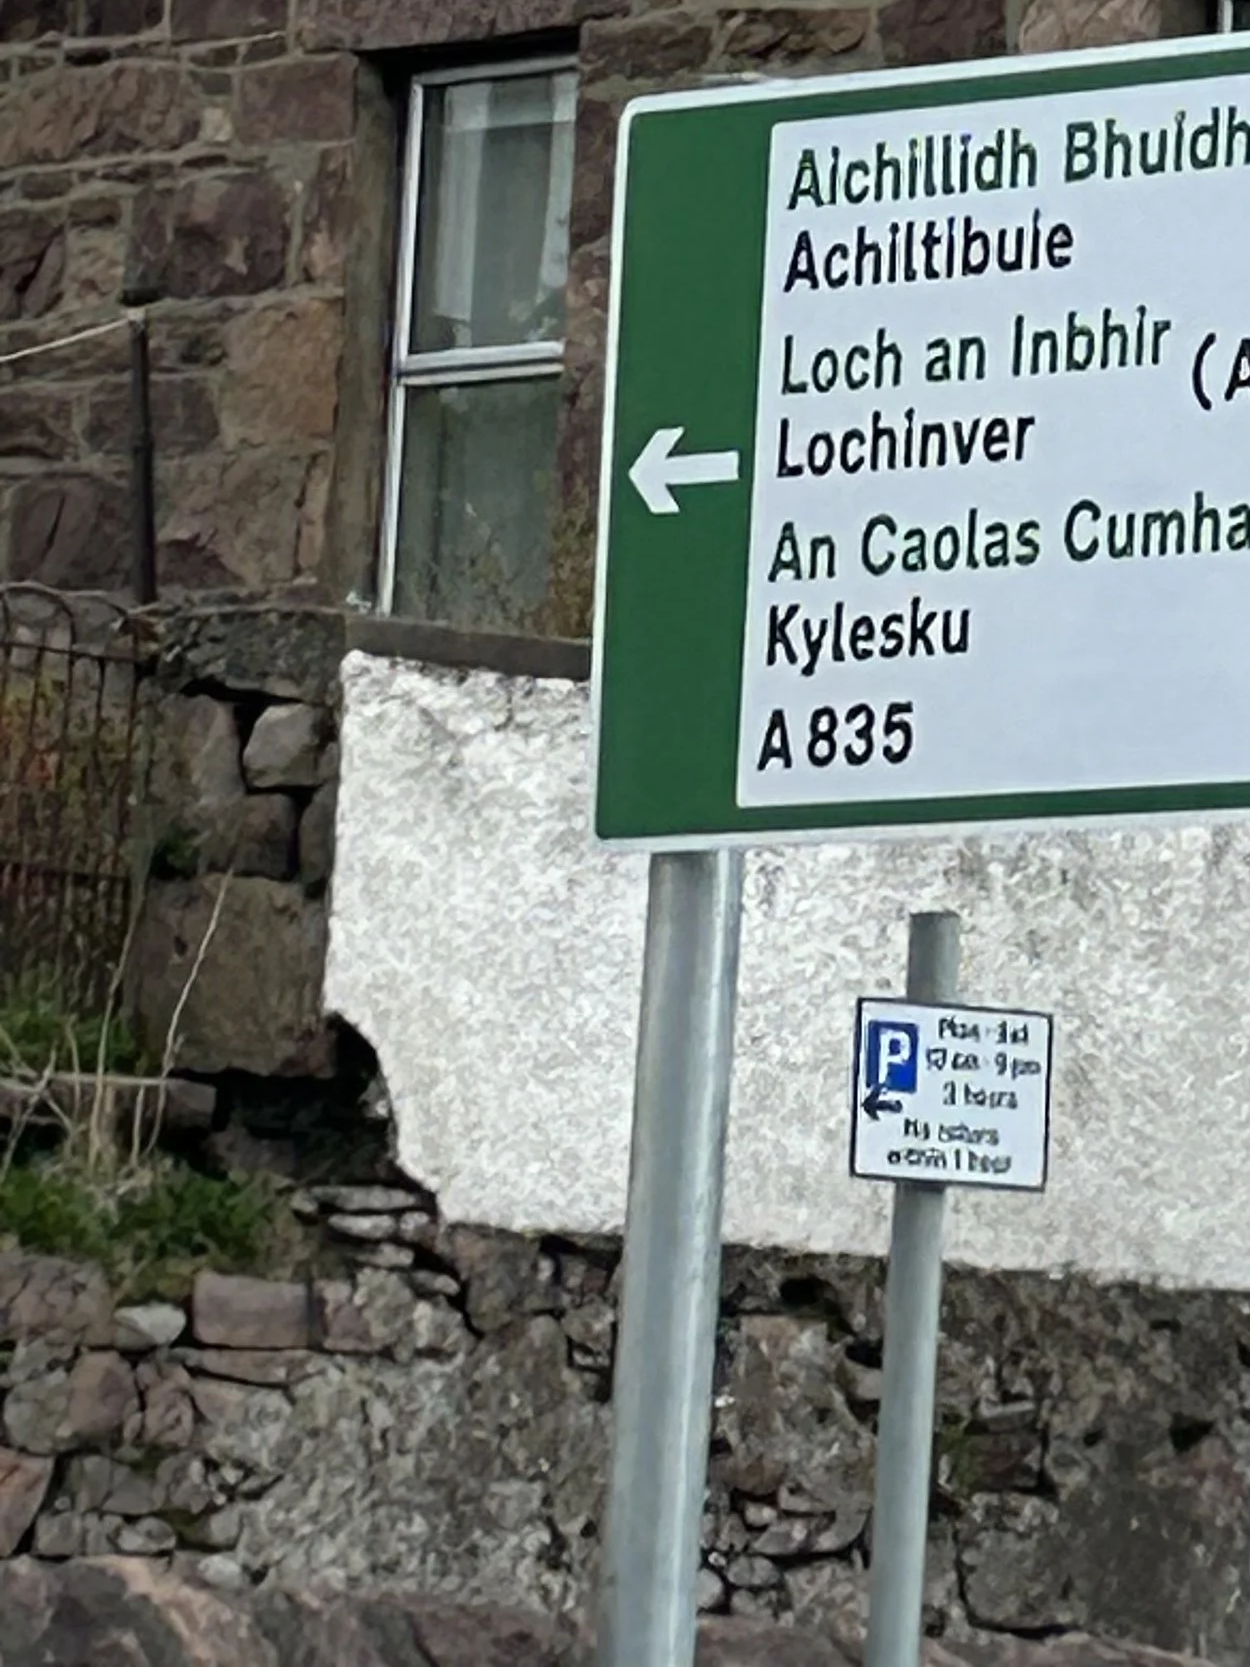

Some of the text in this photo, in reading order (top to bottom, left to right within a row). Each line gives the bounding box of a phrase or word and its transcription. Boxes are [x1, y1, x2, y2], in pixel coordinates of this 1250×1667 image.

[786, 128, 1037, 211] Aichillidh
[783, 207, 1074, 293] Achiltibuie
[781, 304, 1172, 396] Loch an Inbhir
[776, 407, 1036, 479] Lochinver
[767, 521, 836, 583] An
[861, 507, 1040, 577] Caolas
[766, 596, 970, 678] Kylesku
